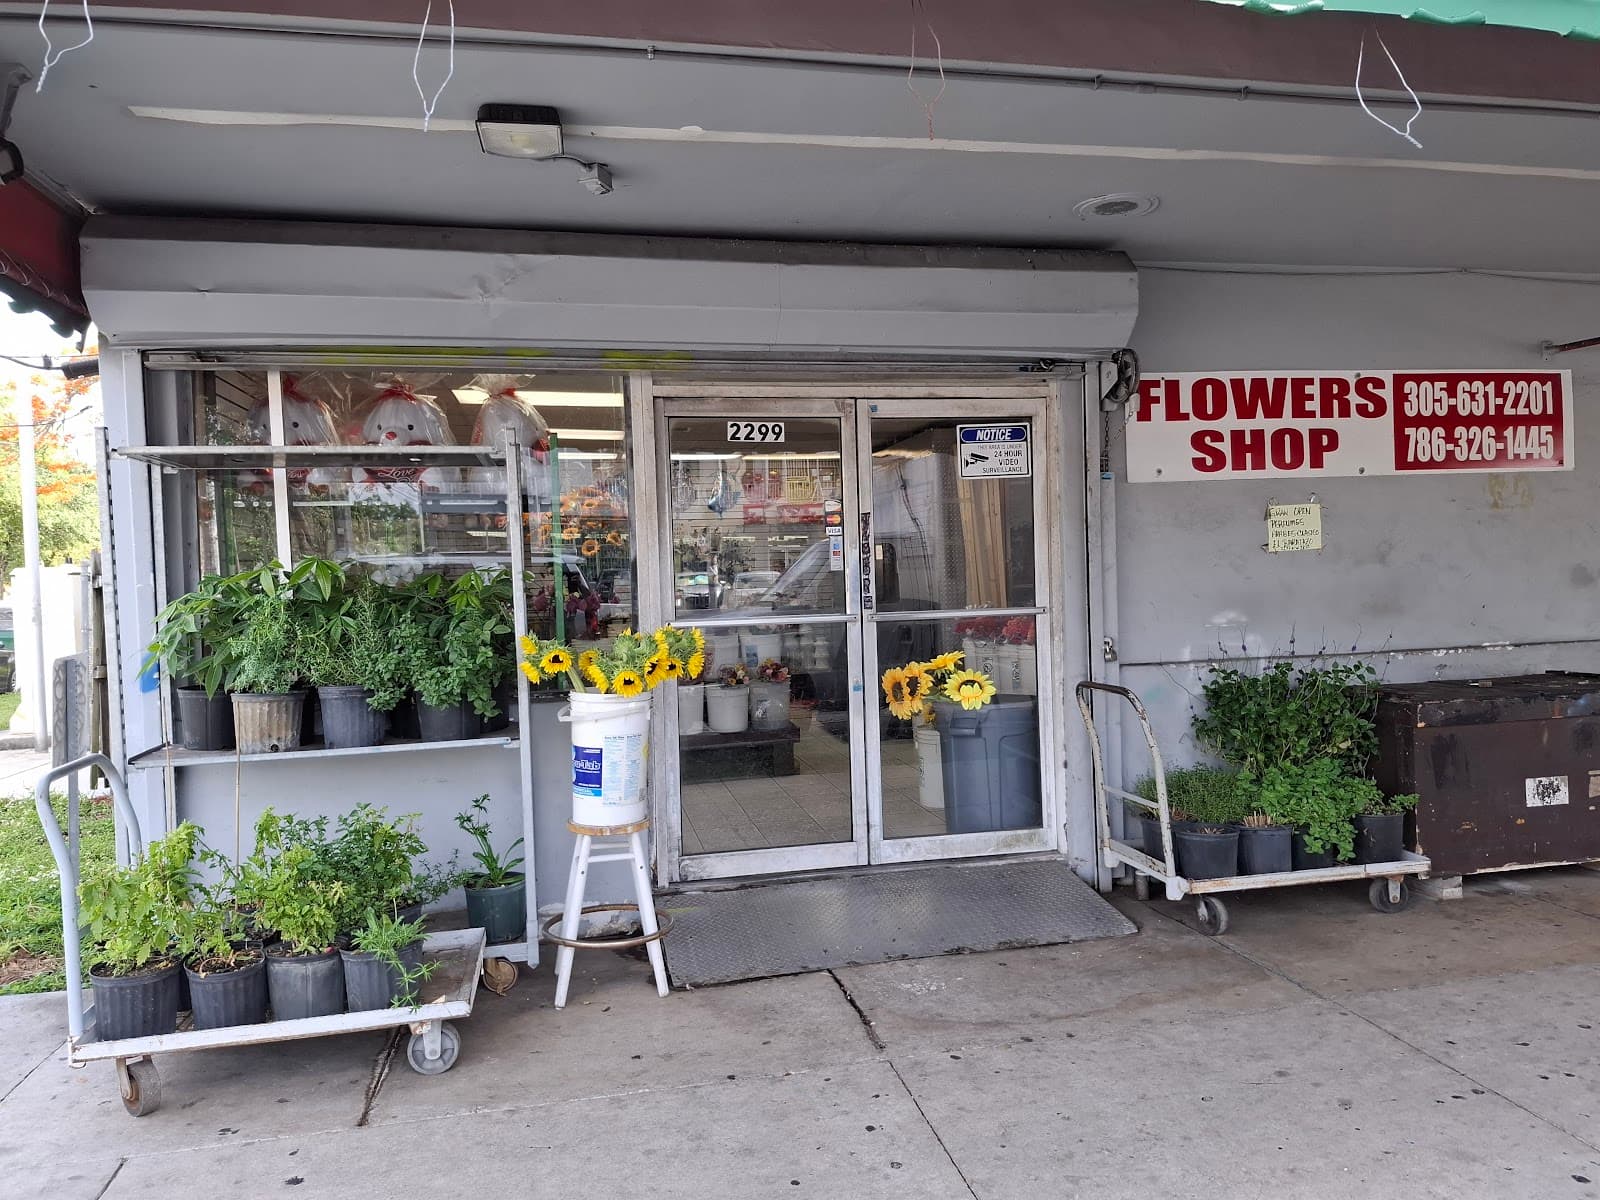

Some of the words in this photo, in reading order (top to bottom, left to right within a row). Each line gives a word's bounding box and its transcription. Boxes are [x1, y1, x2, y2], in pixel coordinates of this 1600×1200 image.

[1136, 376, 1388, 421] FLOWERS
[1403, 380, 1554, 418] 305-631-2201
[729, 423, 783, 441] 2299
[976, 429, 1012, 441] NOTICE
[1190, 428, 1339, 473] SHOP
[1405, 425, 1554, 463] 786-326-1445
[1293, 506, 1311, 516] OPEN
